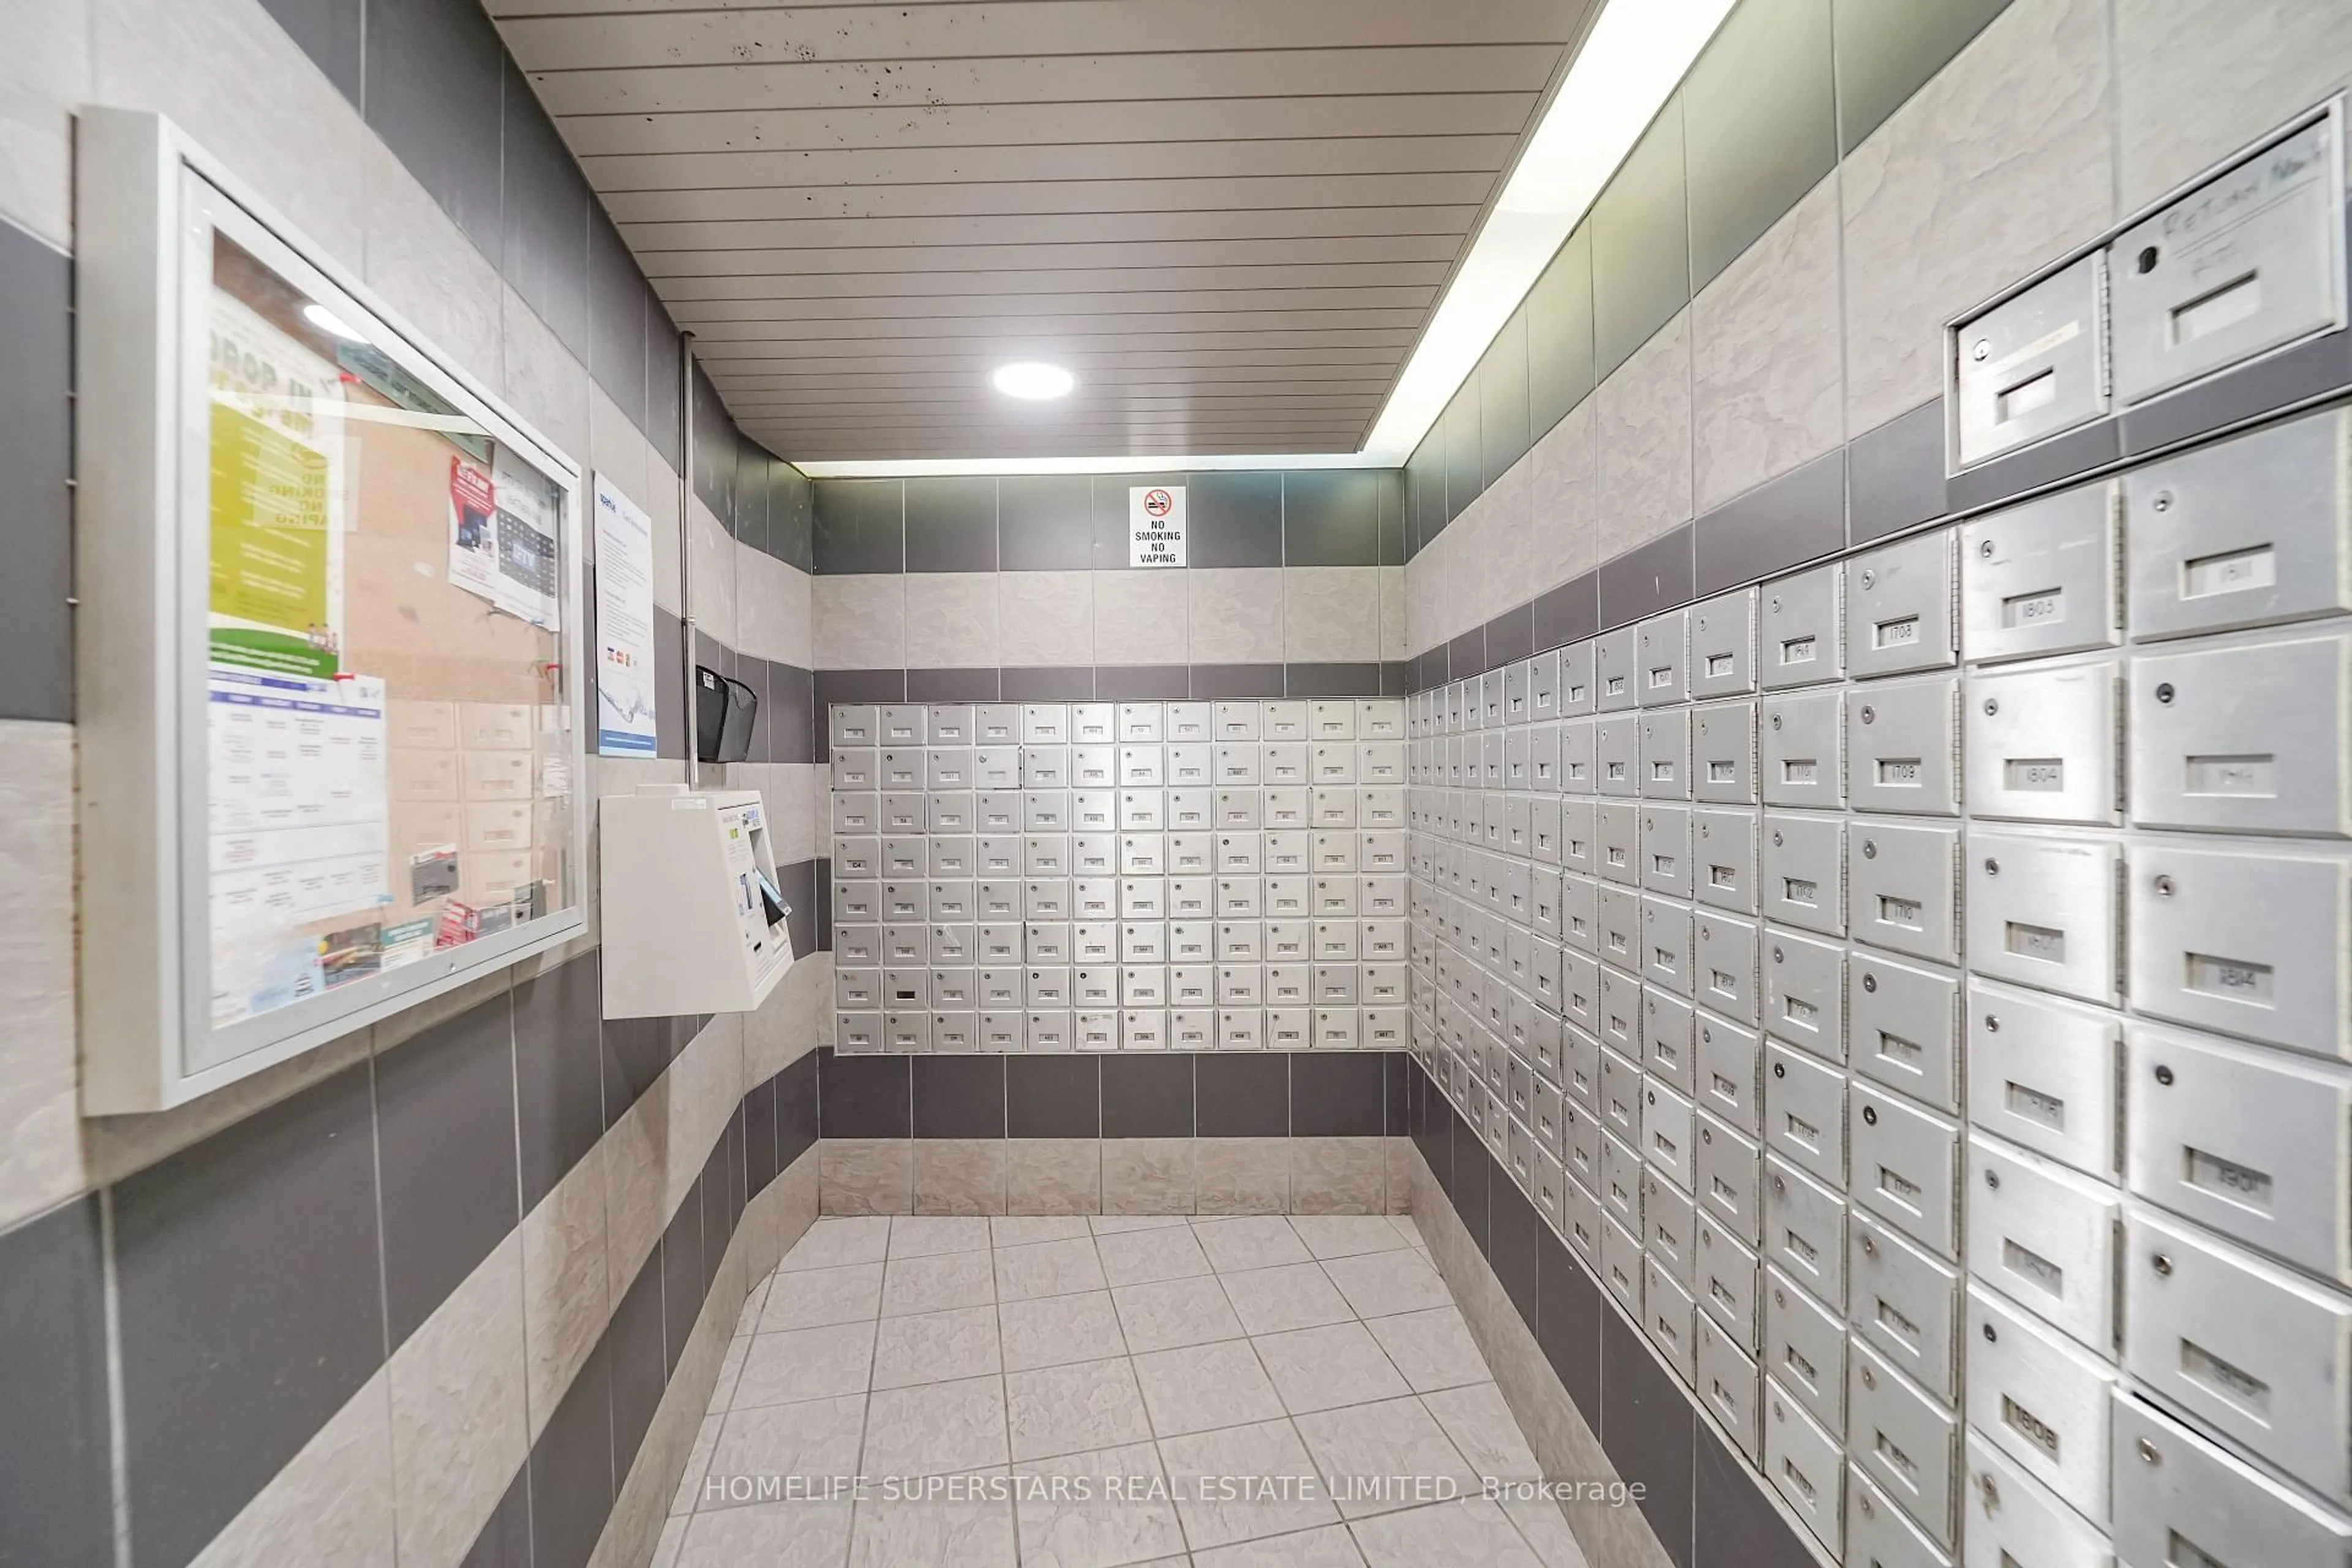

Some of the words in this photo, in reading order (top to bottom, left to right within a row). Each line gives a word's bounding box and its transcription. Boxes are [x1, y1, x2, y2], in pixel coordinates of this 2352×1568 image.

[1151, 520, 1165, 529] NO
[1135, 532, 1181, 541] SMOKING
[1151, 543, 1165, 552] NO
[1140, 554, 1176, 563] VAPING
[1892, 764, 1915, 779] 1709
[2026, 767, 2057, 783] 1804
